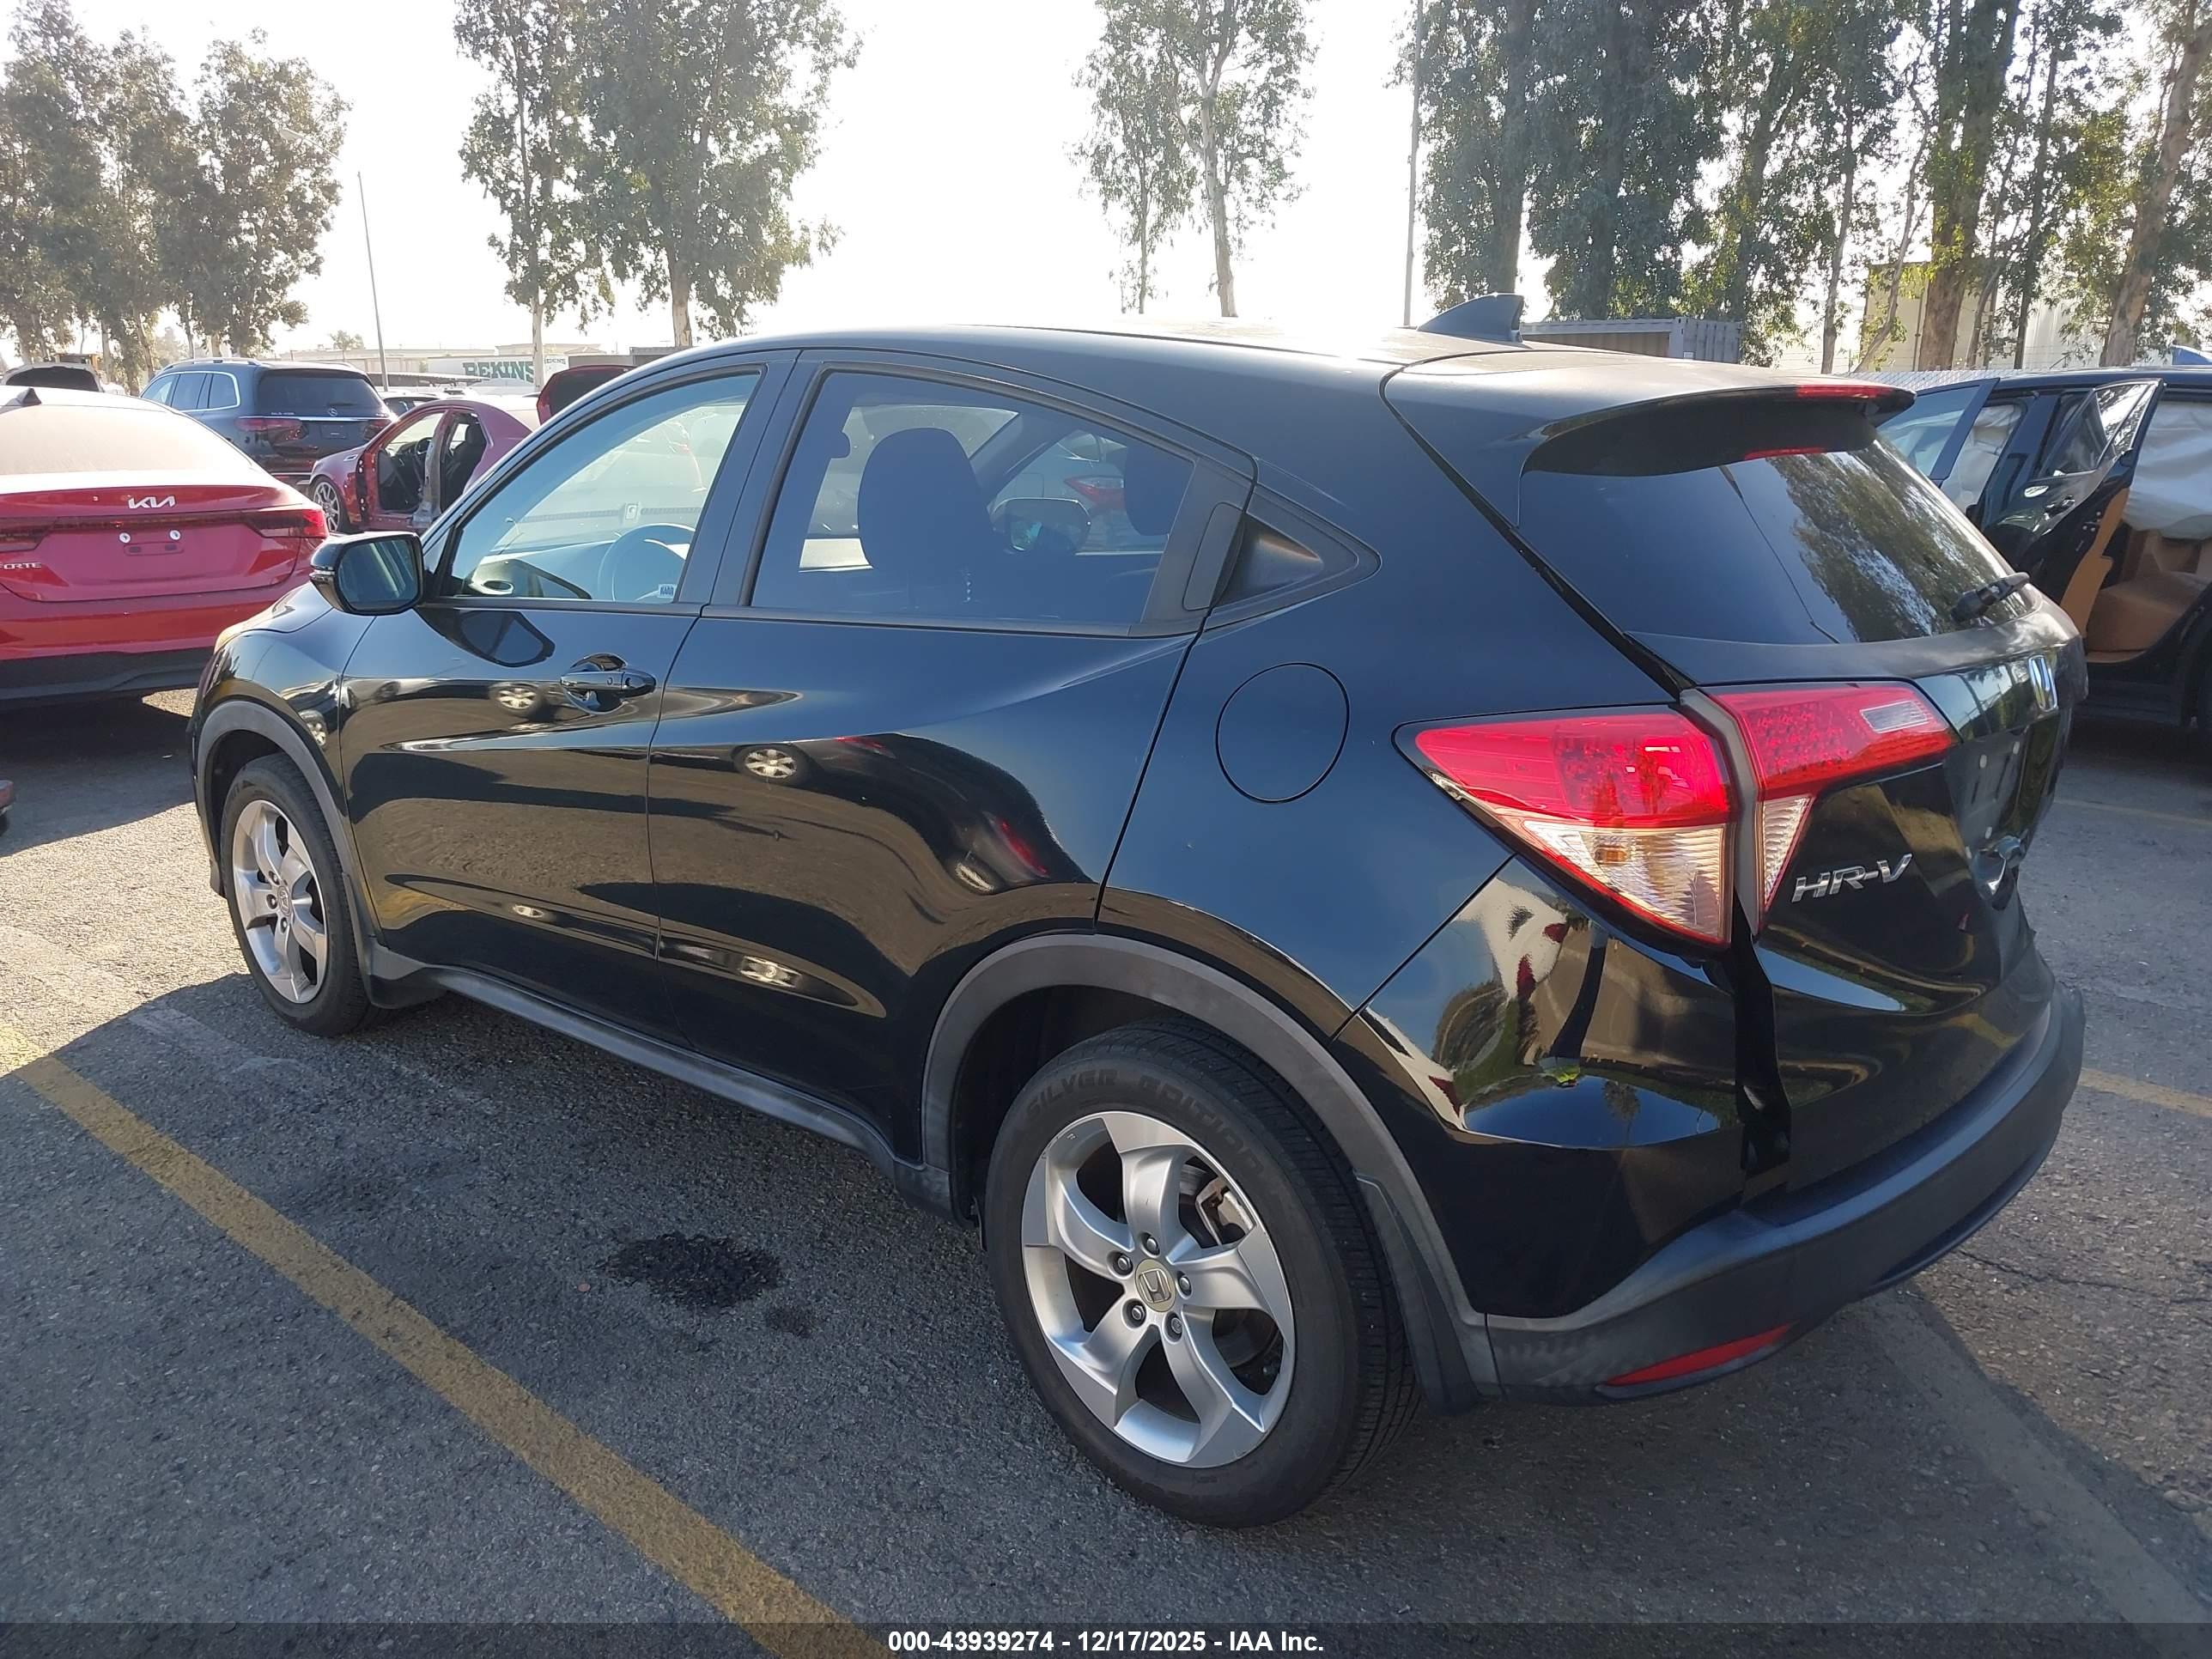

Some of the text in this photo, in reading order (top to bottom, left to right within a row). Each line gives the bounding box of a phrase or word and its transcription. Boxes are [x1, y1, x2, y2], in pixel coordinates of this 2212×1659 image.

[129, 495, 175, 508] KIA
[1791, 853, 1913, 902] HR-V
[1026, 1070, 1266, 1173] SILVER EDITION
